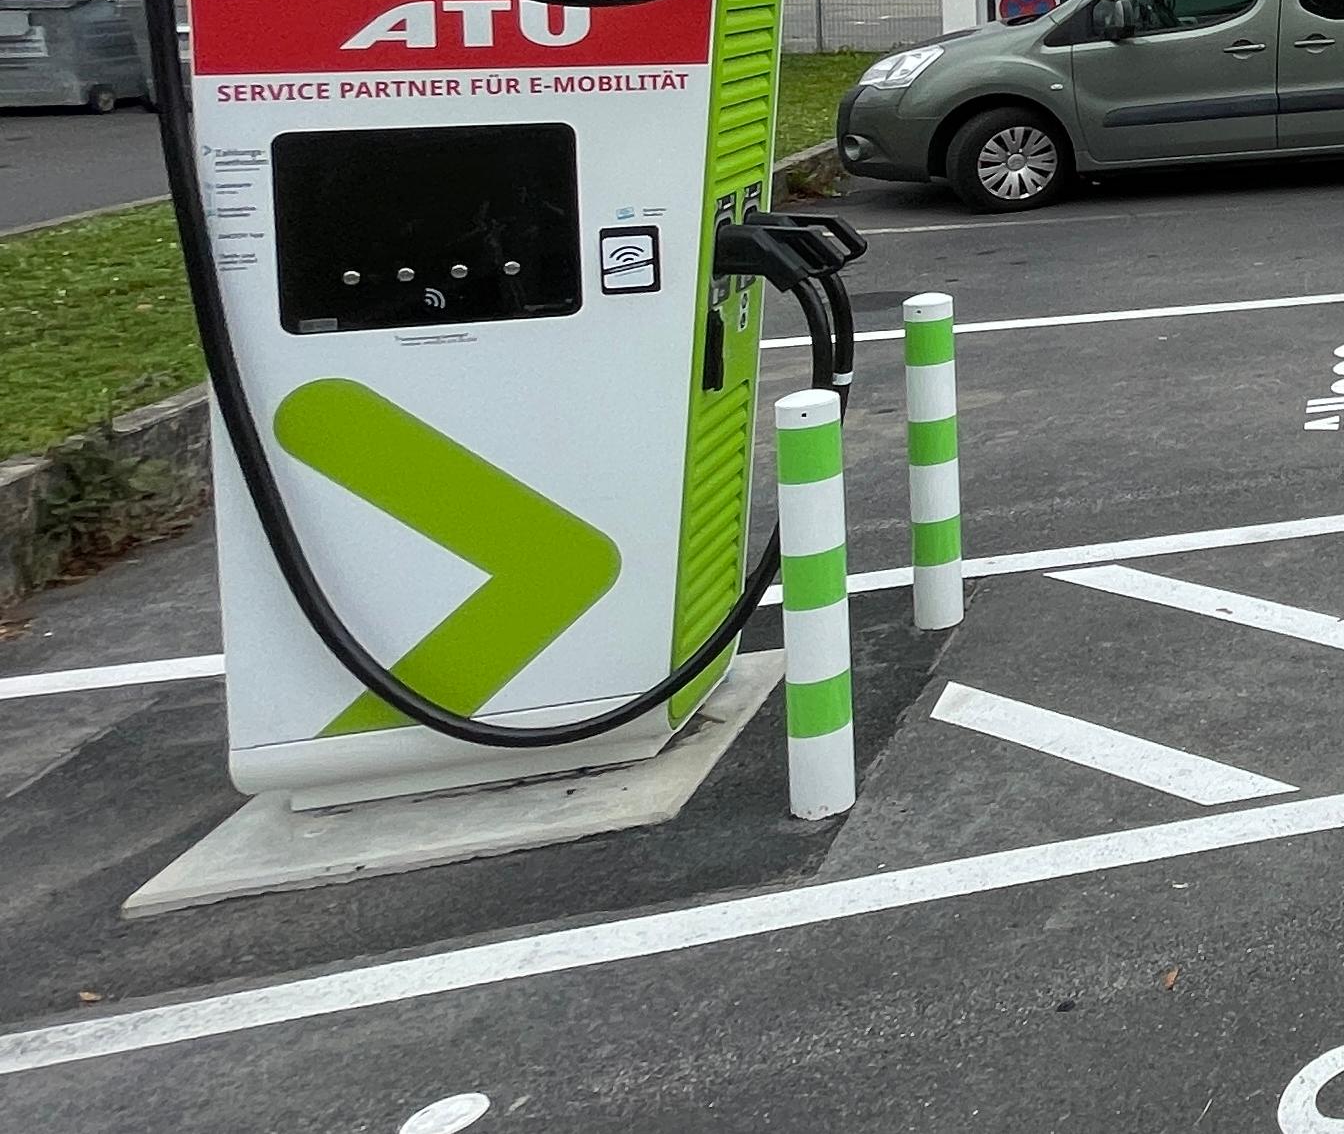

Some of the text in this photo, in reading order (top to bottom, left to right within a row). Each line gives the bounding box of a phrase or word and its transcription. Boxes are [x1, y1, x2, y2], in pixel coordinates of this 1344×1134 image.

[217, 69, 689, 102] SERVICE PARTNER FÜR E-MOBILITÄT
